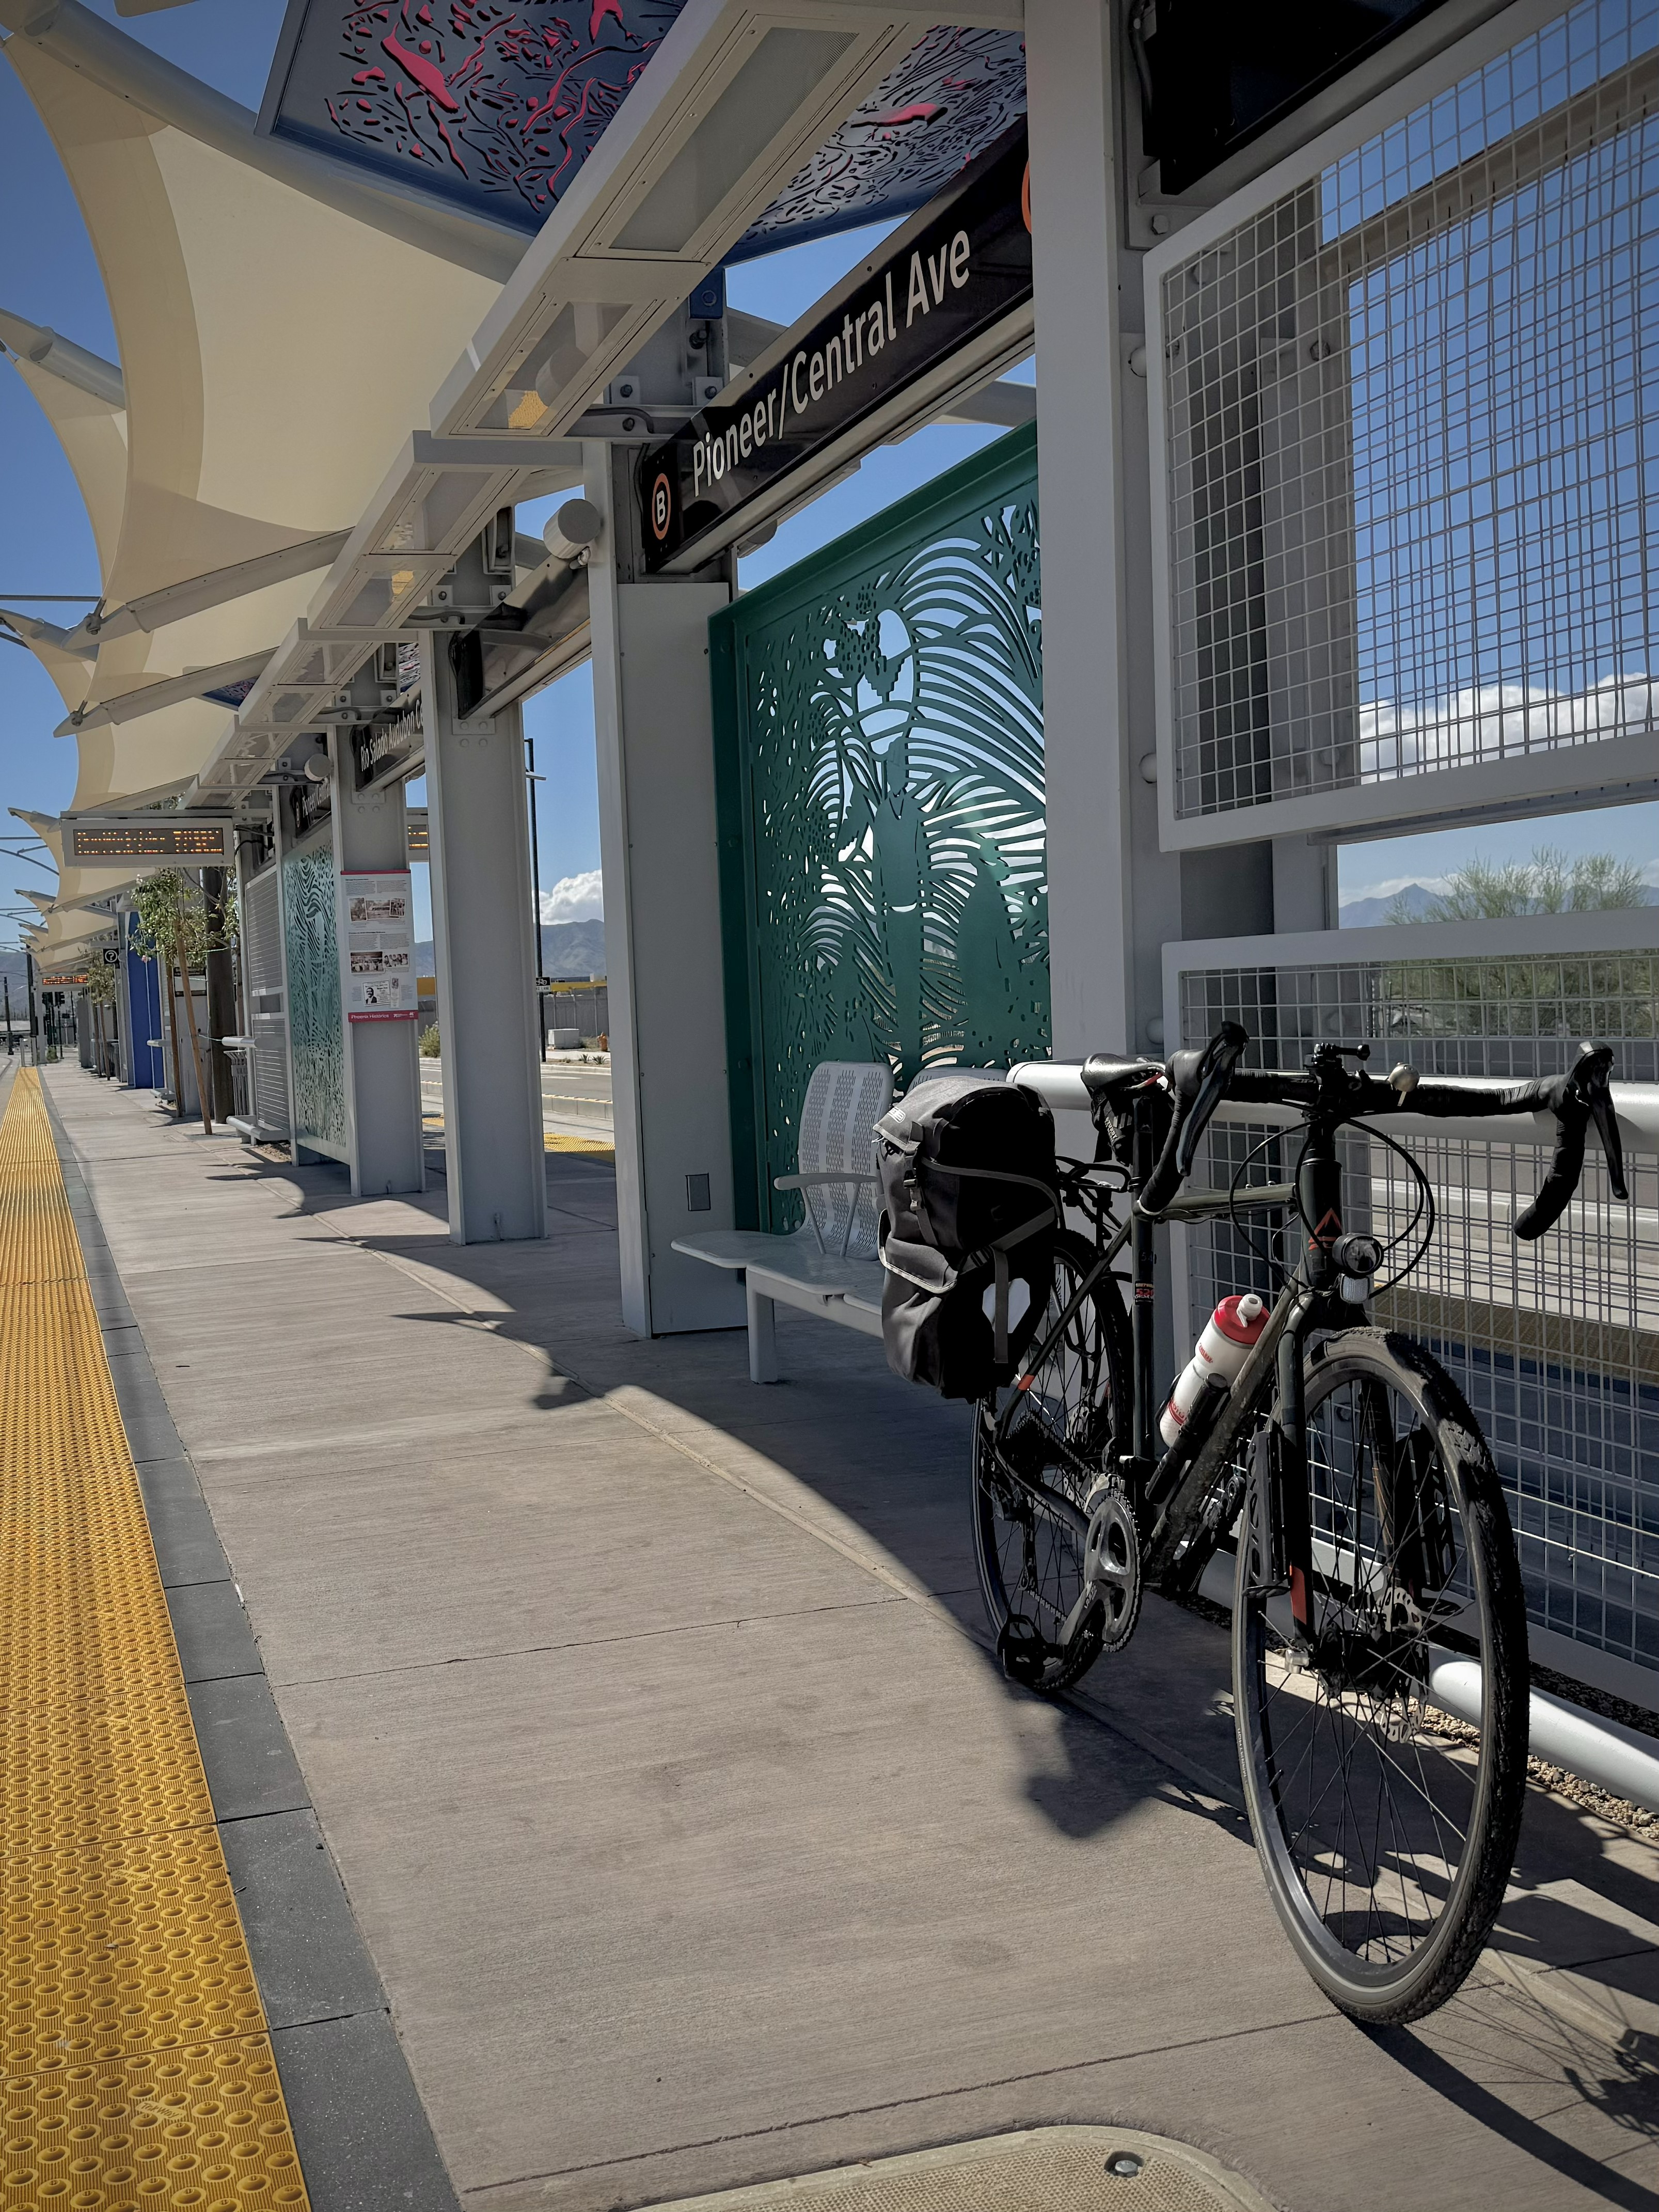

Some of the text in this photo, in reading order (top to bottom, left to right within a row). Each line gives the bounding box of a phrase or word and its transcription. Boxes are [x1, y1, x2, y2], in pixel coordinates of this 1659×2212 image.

[693, 230, 970, 497] Pioneer/Central Ave
[656, 490, 666, 523] B
[370, 728, 387, 764] Salado
[389, 710, 415, 750] Audubon
